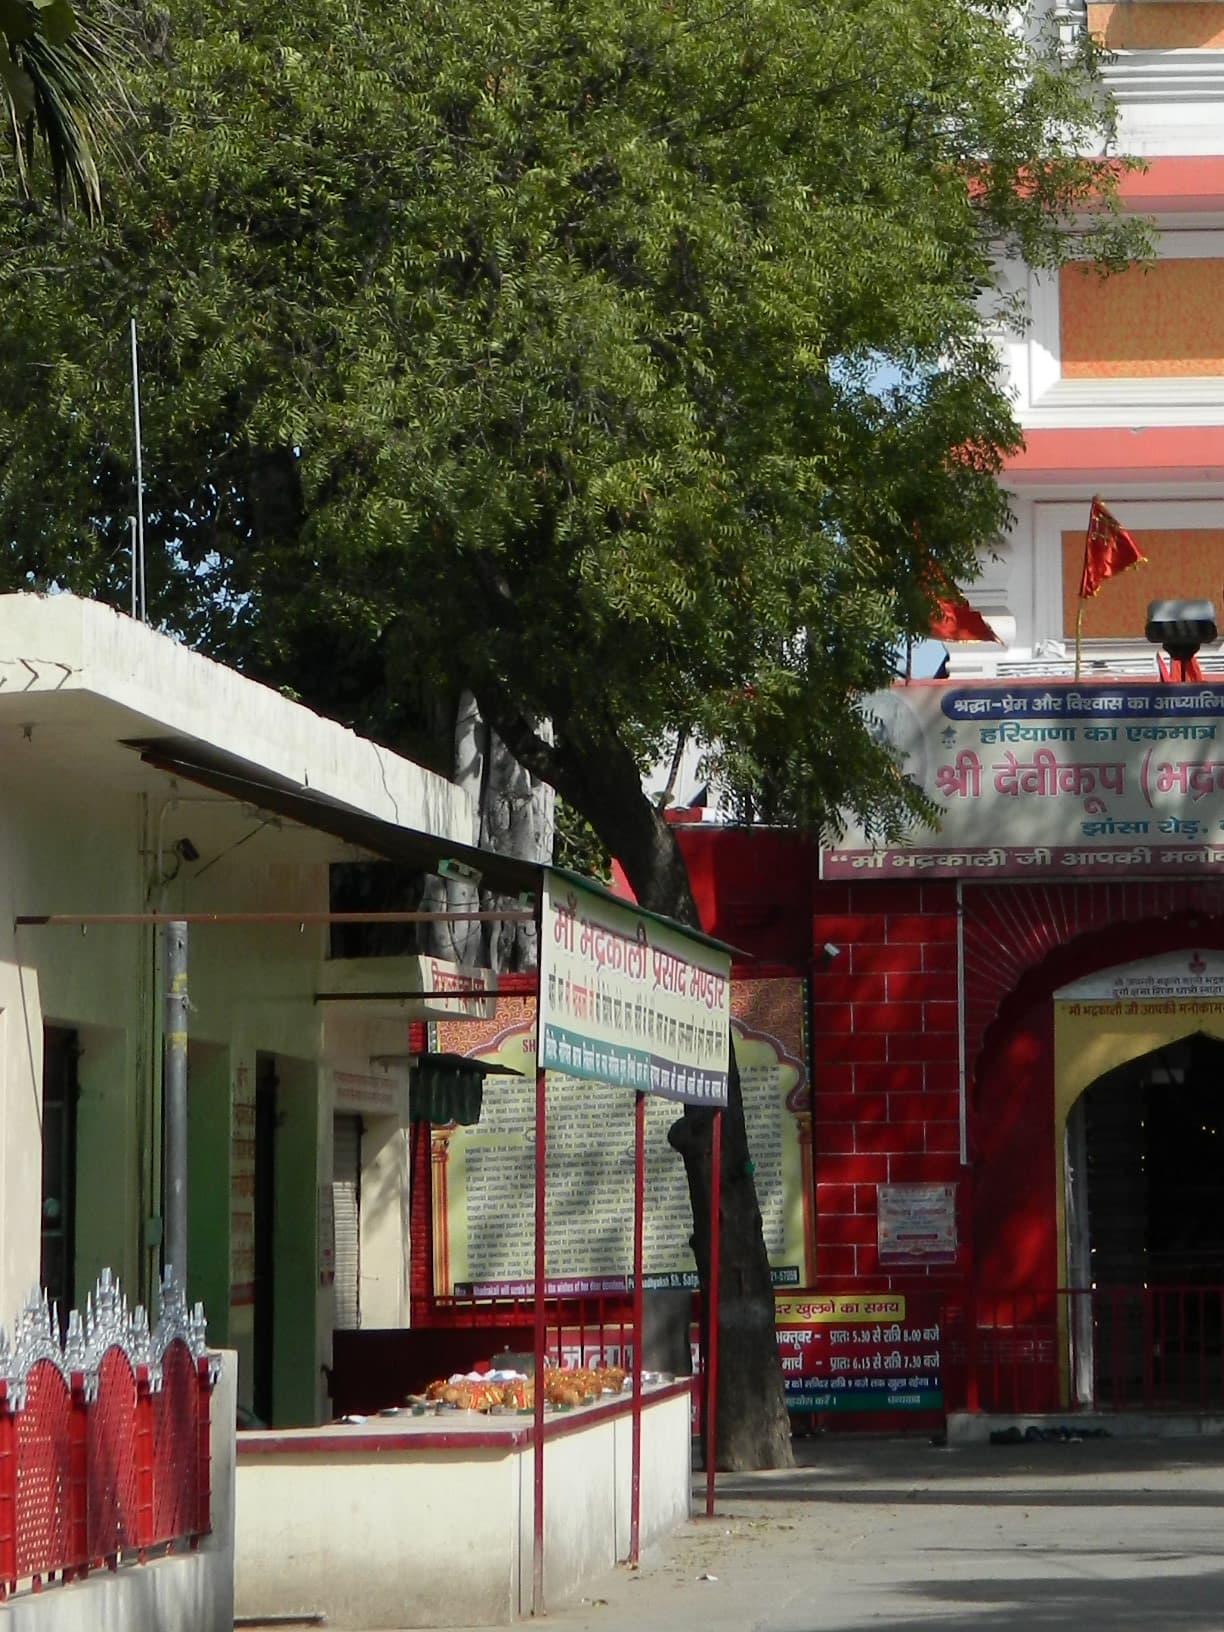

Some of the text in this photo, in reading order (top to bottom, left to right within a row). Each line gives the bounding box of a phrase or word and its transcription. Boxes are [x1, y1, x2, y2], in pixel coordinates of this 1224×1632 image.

[1032, 692, 1061, 711] और
[1066, 692, 1123, 711] विश्वास
[1128, 695, 1149, 709] का
[980, 721, 1076, 744] हरियाणा
[1084, 726, 1117, 741] का
[1126, 724, 1217, 742] एकमात्र
[935, 749, 982, 798] श्री
[991, 748, 1127, 815] देवीकूप
[1080, 817, 1151, 836] झांसा
[891, 848, 1008, 870] भद्रकाली
[1014, 848, 1051, 866] जी
[1060, 846, 1152, 866] आपकी
[580, 921, 649, 979] भद्रकाली
[651, 946, 689, 997] प्रसाद
[689, 966, 726, 1010] भण्डार
[1124, 1000, 1138, 1016] जी
[796, 1300, 836, 1319] खुलने
[840, 1303, 859, 1314] का
[864, 1303, 899, 1314] समय
[852, 1330, 871, 1343] 5.30
[872, 1324, 881, 1344] से
[923, 1324, 940, 1343] बजे
[782, 1352, 803, 1370] मार्च
[872, 1352, 881, 1370] से
[923, 1350, 940, 1369] बजे
